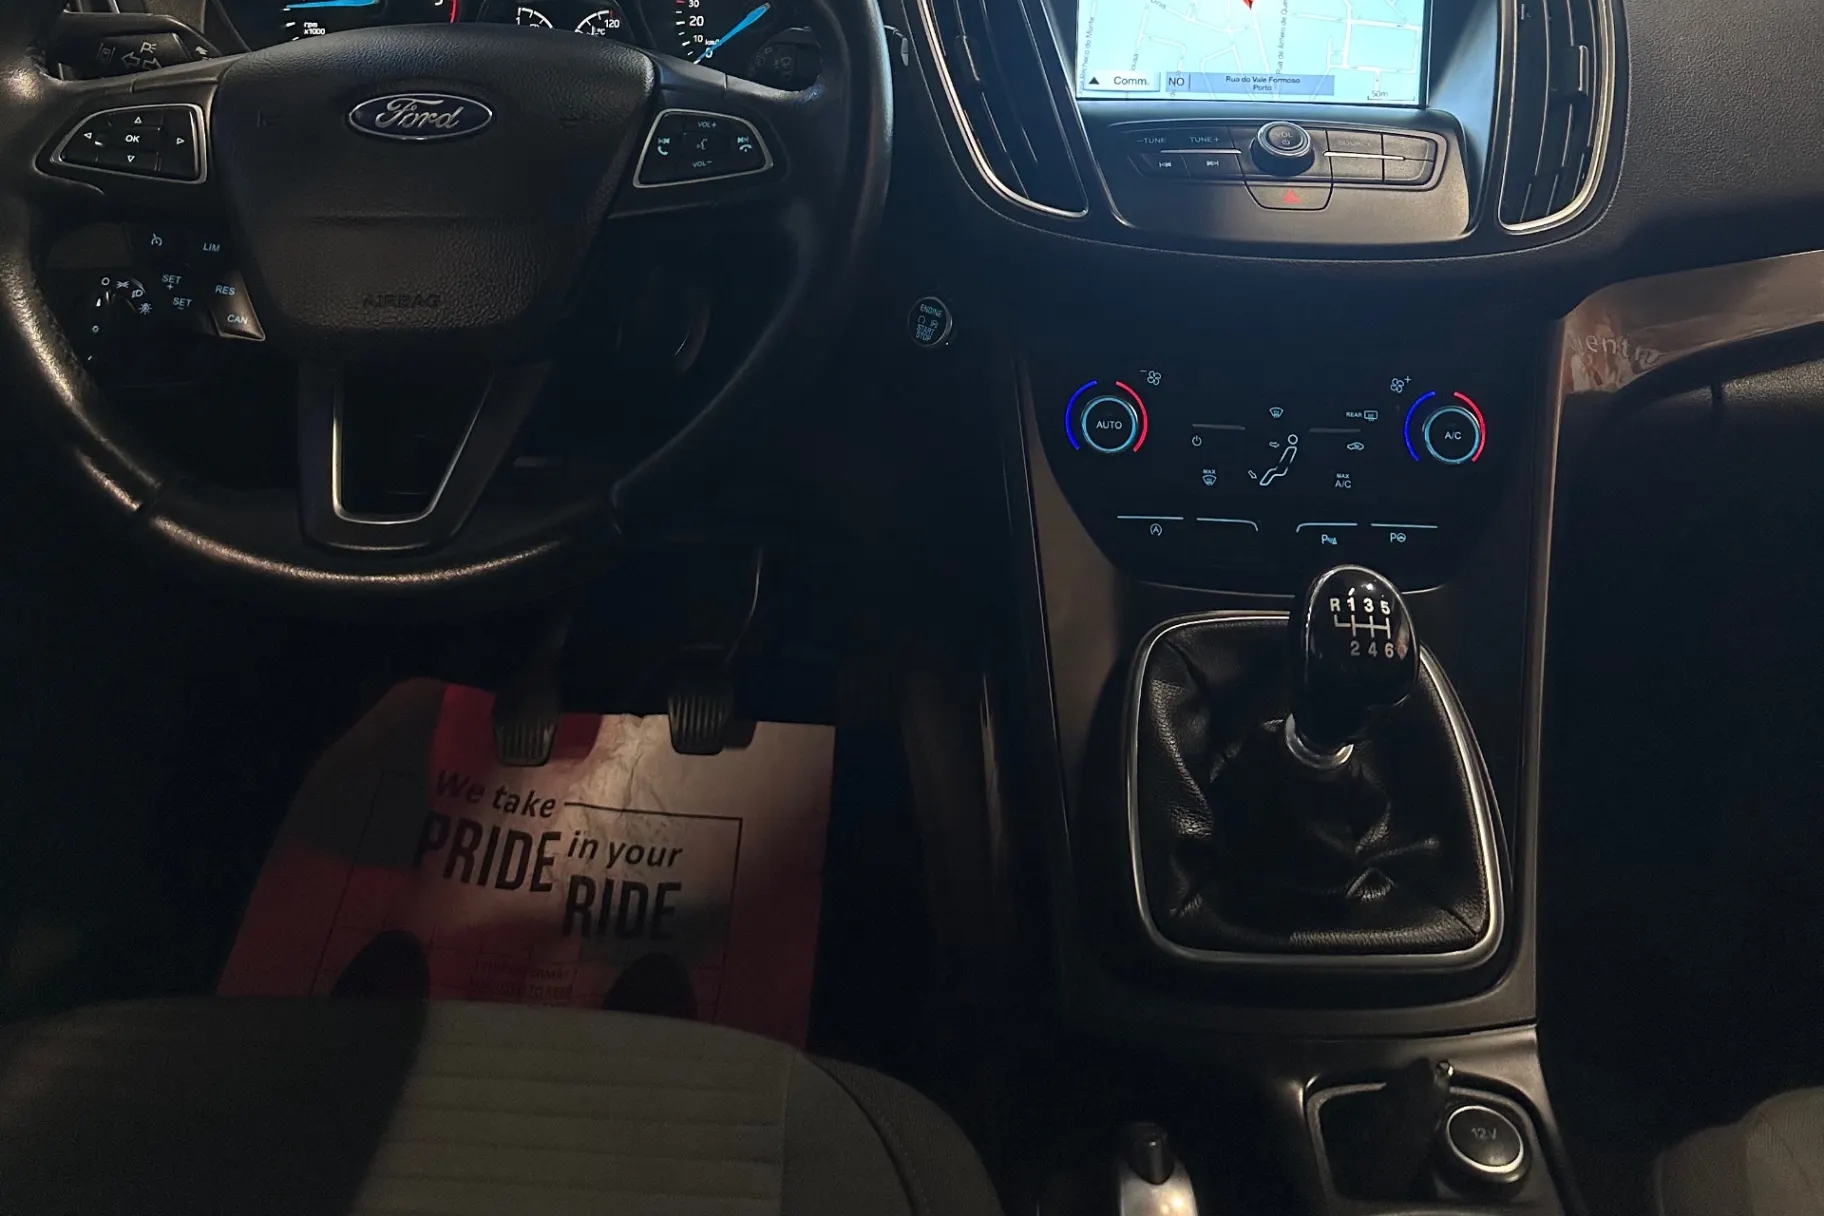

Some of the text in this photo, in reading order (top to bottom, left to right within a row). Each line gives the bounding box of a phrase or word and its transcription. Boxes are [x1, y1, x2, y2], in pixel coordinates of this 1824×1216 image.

[688, 0, 700, 8] 30
[604, 19, 620, 28] 120
[689, 15, 705, 27] 20
[693, 35, 704, 43] 10
[1168, 77, 1185, 86] NO
[1268, 76, 1301, 84] Formoso
[375, 98, 464, 128] Ford
[125, 134, 140, 143] OK
[203, 242, 220, 253] LIM
[162, 274, 182, 284] SET
[215, 285, 236, 296] RES
[172, 297, 192, 307] SET
[227, 314, 248, 325] CAN
[1096, 421, 1122, 429] AUTO
[1444, 431, 1462, 440] A/C
[1335, 480, 1351, 489] A/C
[1329, 596, 1391, 615] R 1 3 5
[1350, 641, 1394, 658] 2 4 6
[436, 769, 556, 818] We take
[413, 810, 684, 892] PRIDE in your
[562, 874, 681, 939] RIDE
